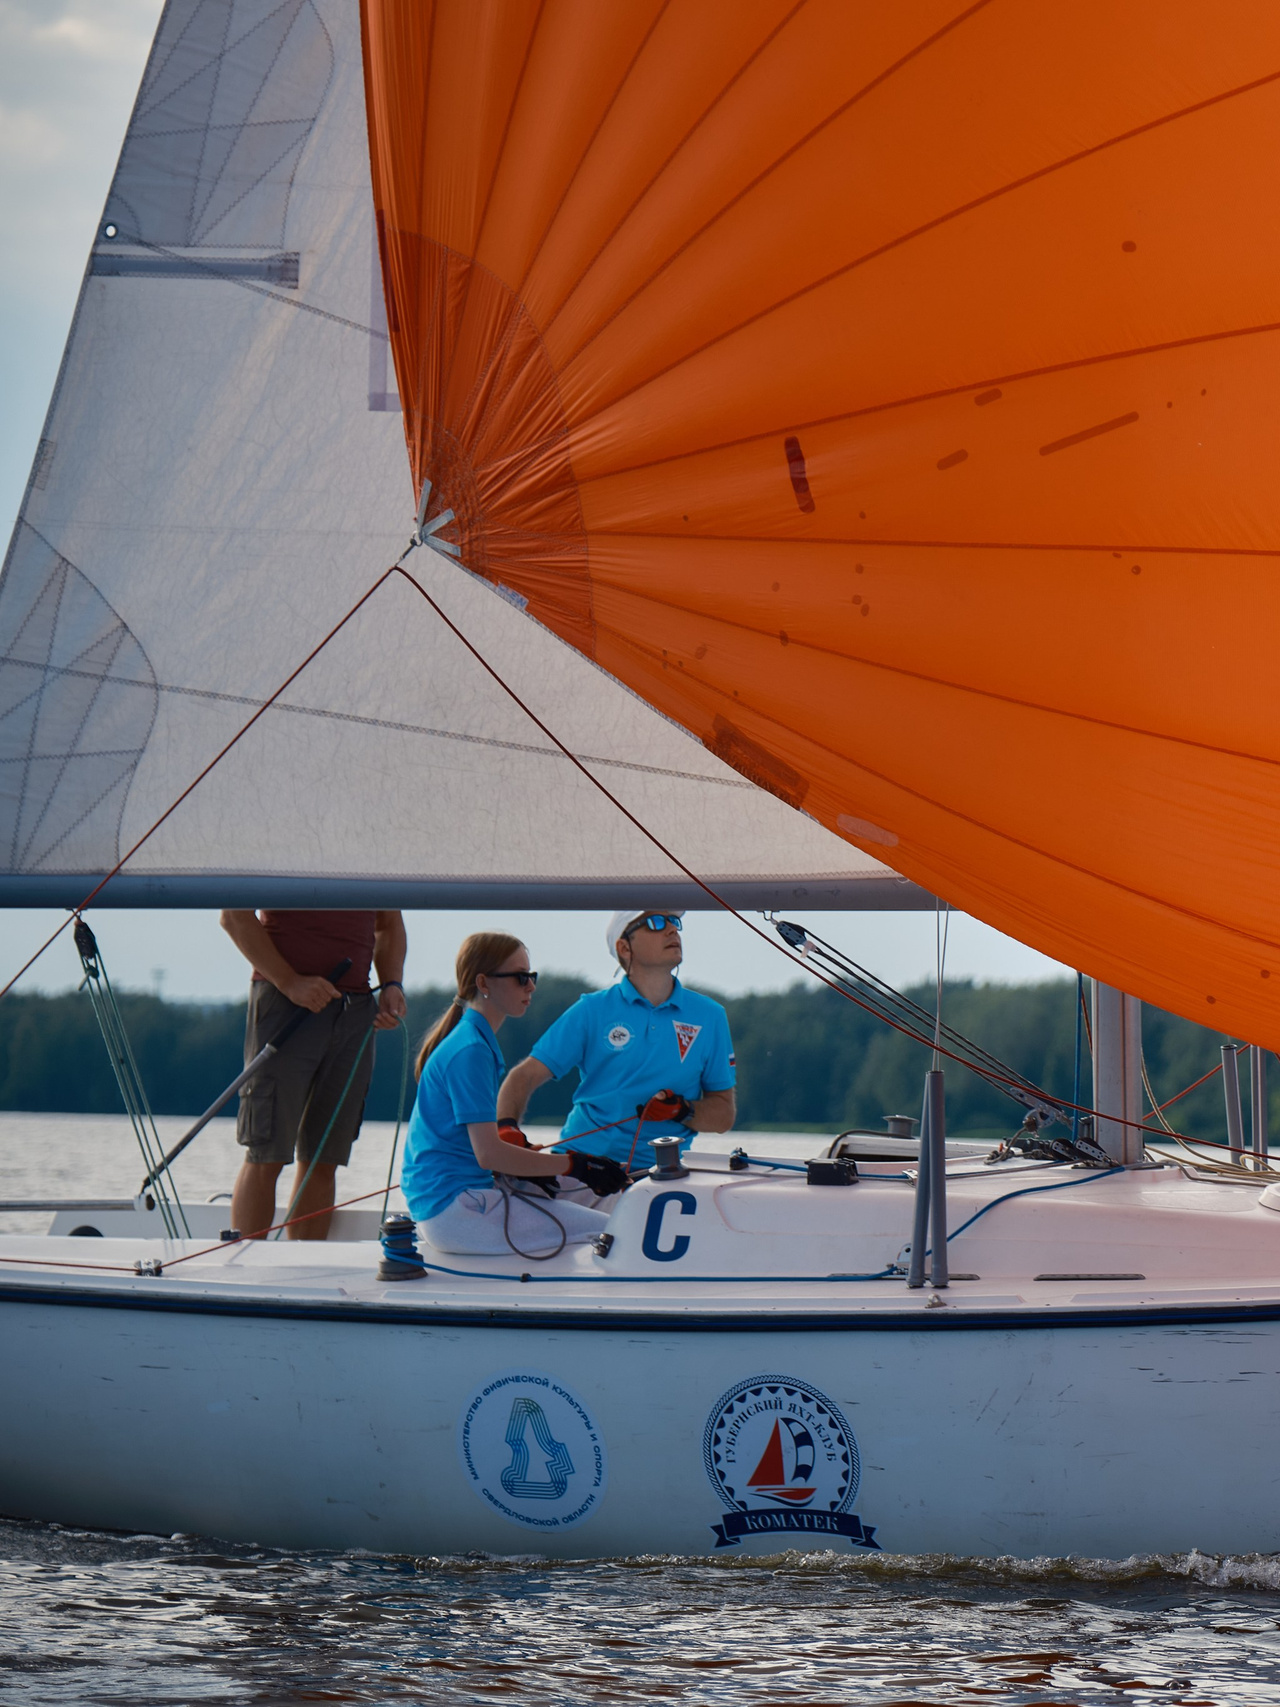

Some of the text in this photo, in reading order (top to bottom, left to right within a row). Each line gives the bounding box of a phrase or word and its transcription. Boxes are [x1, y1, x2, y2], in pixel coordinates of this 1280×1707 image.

[641, 1190, 697, 1262] C
[462, 1375, 603, 1488] МИНИСТЕРСТВО ФИЗИЧЕСКОЙ КУЛЬТУРЫ И СПОРТА
[726, 1396, 837, 1464] ГУБЕРНСКИЙ ЯХТ-КЛУБ
[482, 1487, 597, 1527] СВЕРДЛОВСКОЙ ОБЛАСТИ
[744, 1513, 840, 1531] КОМАТЕК
